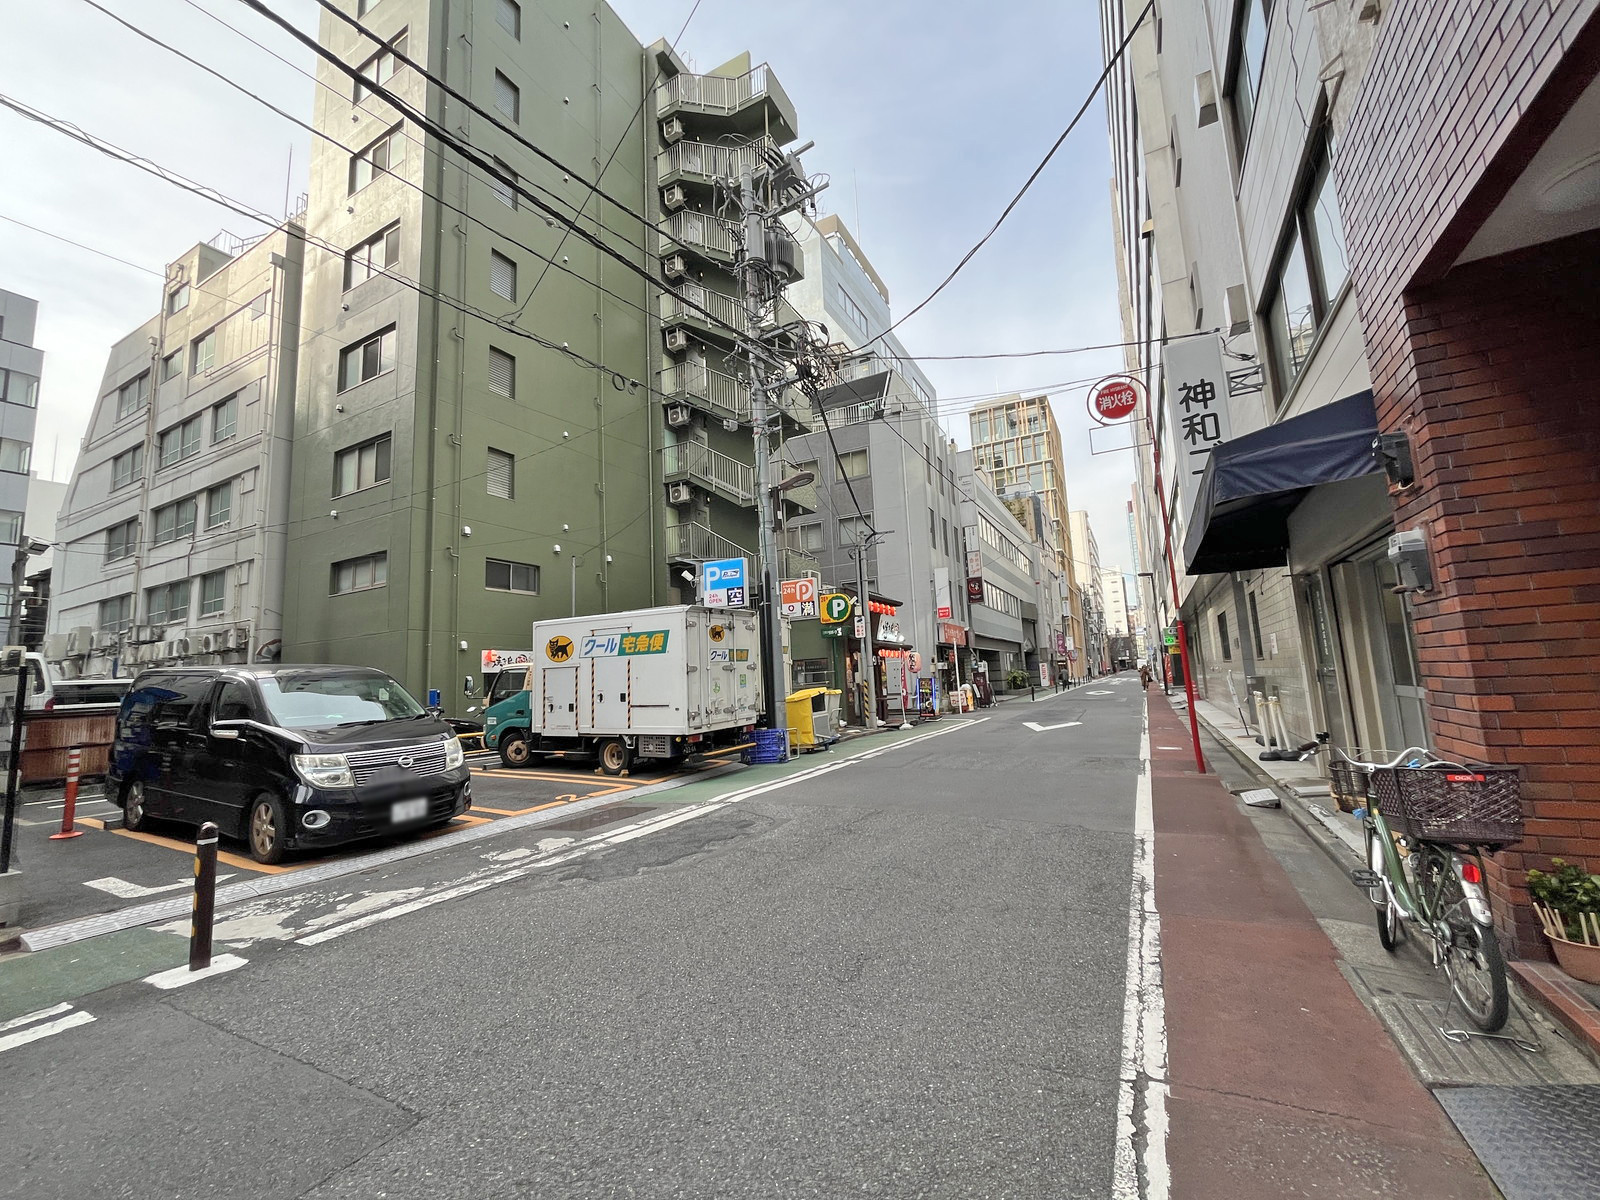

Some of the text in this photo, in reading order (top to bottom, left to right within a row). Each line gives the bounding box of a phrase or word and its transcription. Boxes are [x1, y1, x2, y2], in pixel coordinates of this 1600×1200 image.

[1098, 390, 1135, 411] 消火栓
[705, 566, 720, 592] P
[728, 587, 743, 606] 空
[783, 587, 796, 595] 24h
[832, 599, 845, 618] P
